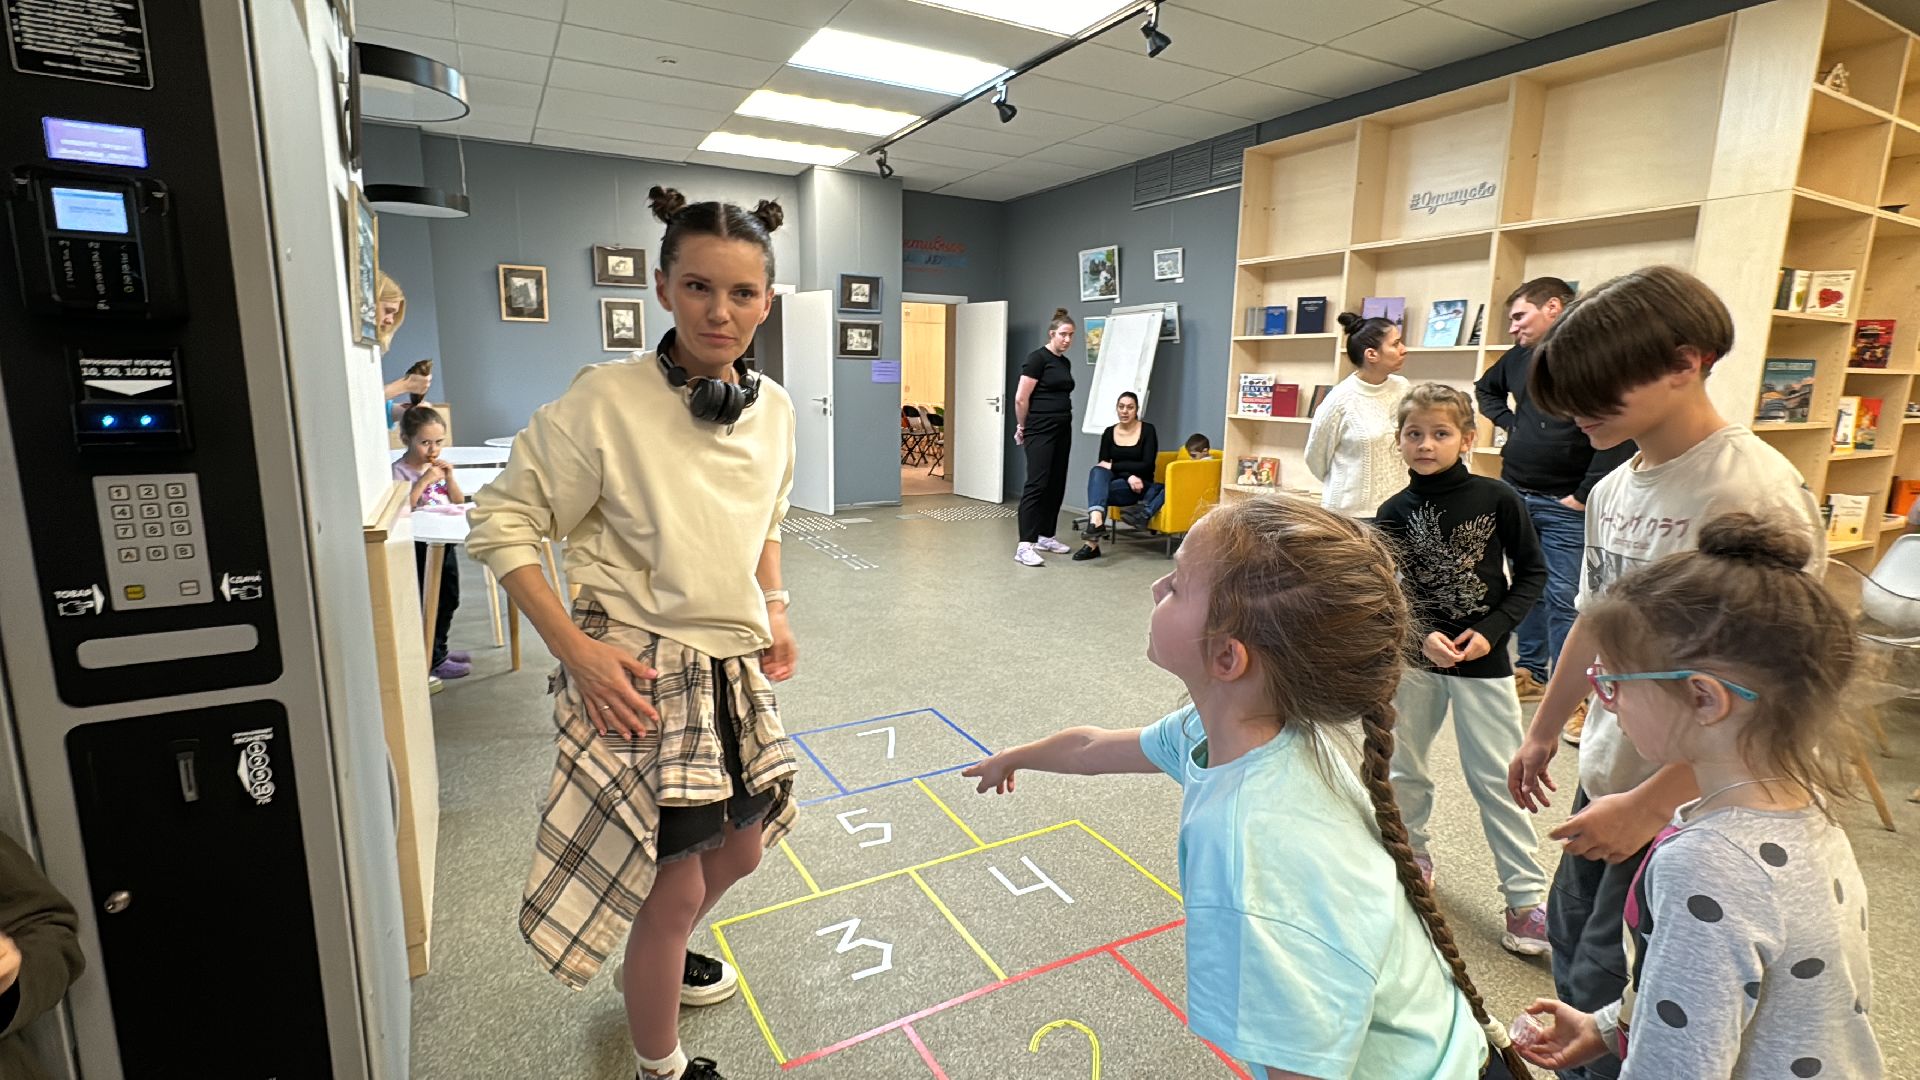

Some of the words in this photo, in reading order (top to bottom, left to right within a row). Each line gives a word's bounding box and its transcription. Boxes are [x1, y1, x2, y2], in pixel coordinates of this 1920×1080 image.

[82, 367, 102, 377] 10,
[103, 367, 123, 377] 50,
[125, 367, 148, 376] 100
[856, 726, 896, 759] 7
[836, 807, 892, 848] 5
[987, 855, 1075, 904] 4
[815, 917, 893, 981] 3
